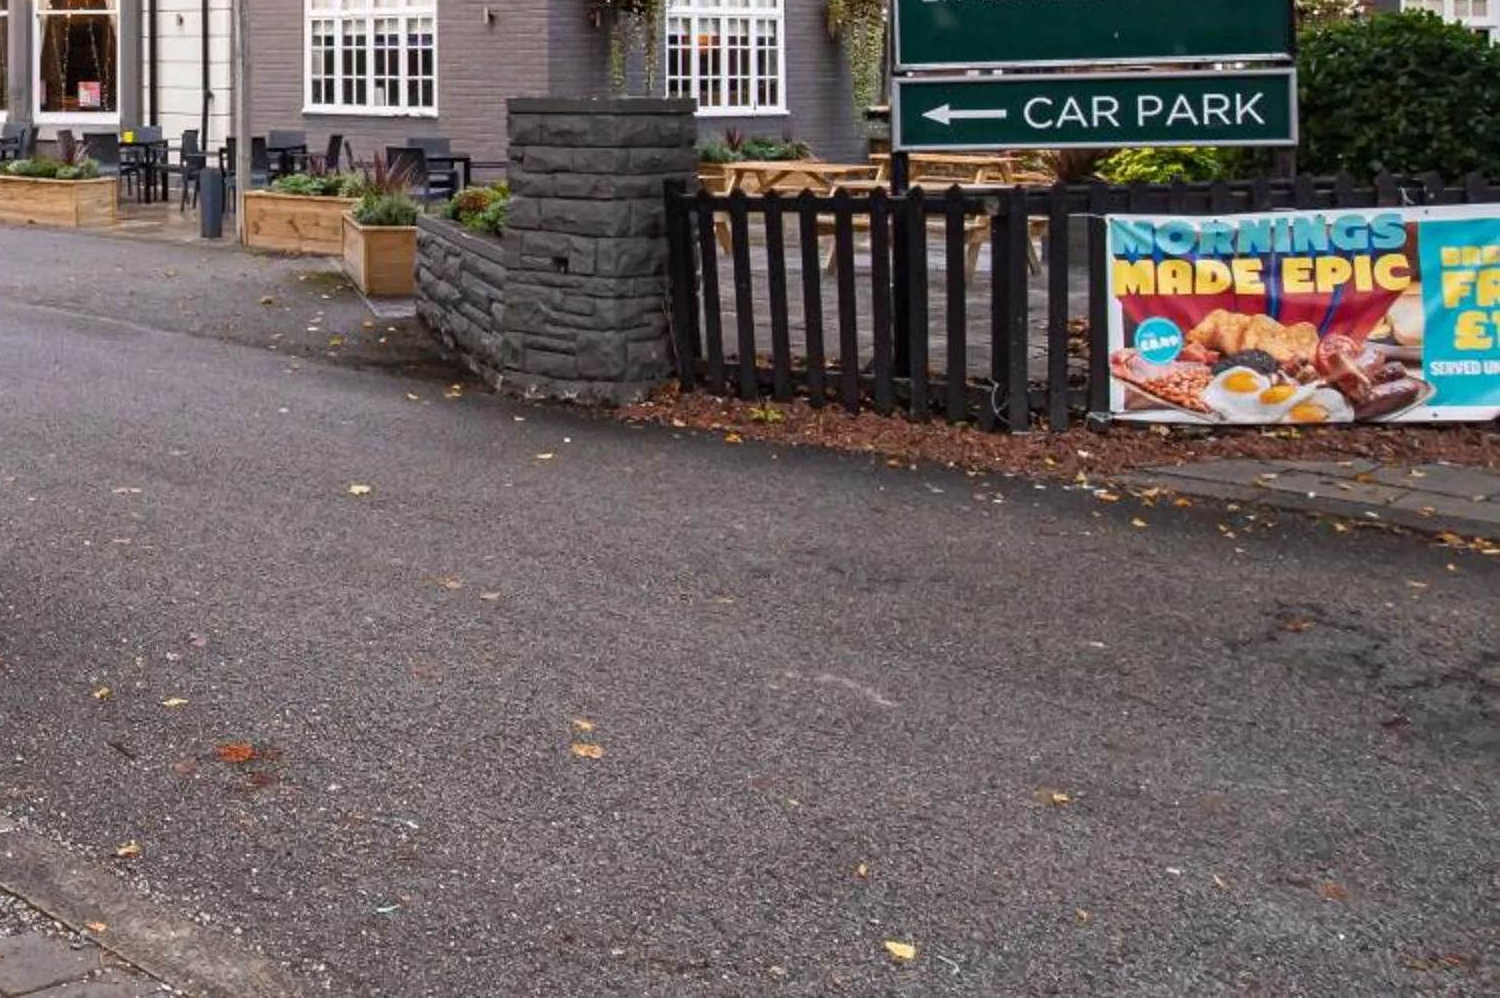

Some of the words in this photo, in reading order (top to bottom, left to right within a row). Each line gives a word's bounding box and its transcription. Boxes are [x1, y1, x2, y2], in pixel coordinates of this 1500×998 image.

[1023, 95, 1120, 130] CAR
[1136, 92, 1266, 127] PARK
[1109, 213, 1407, 254] MORNINGS
[1113, 257, 1266, 296] MADE
[1282, 254, 1412, 294] EPIC
